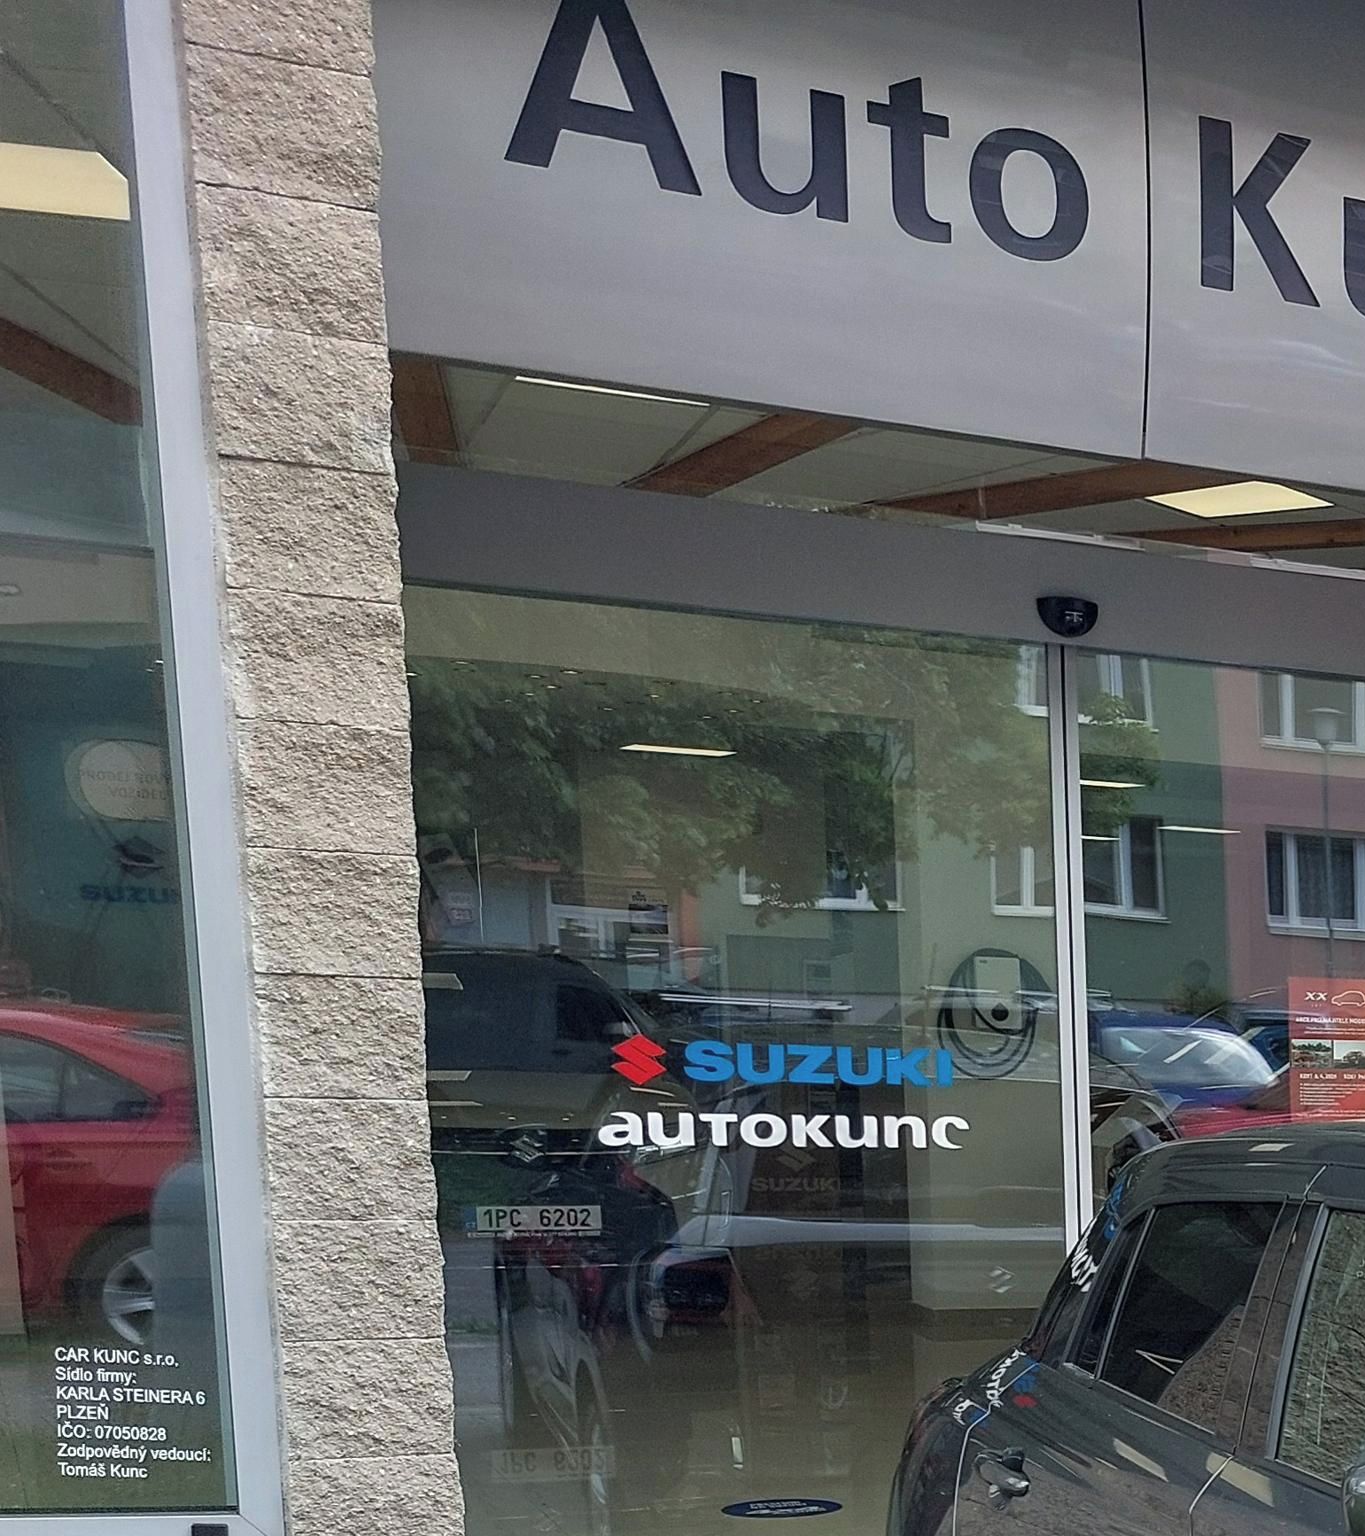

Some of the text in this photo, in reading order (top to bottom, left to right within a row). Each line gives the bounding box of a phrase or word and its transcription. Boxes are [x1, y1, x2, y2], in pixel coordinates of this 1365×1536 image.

[504, 0, 1089, 262] Auto
[683, 1039, 953, 1088] SUZUKI
[483, 1208, 592, 1228] 1PC 6202
[54, 1346, 90, 1363] CAR
[93, 1348, 140, 1364] KUNC
[55, 1367, 137, 1386] Sídlo firmy:
[56, 1386, 206, 1405] KARLA STEINERA 6
[56, 1402, 109, 1420] PLZEŇ
[57, 1421, 167, 1441] IČO: 07050828
[57, 1443, 212, 1462] Zodpovědný vedoucí:
[57, 1462, 148, 1478] Tomáš Kunc
